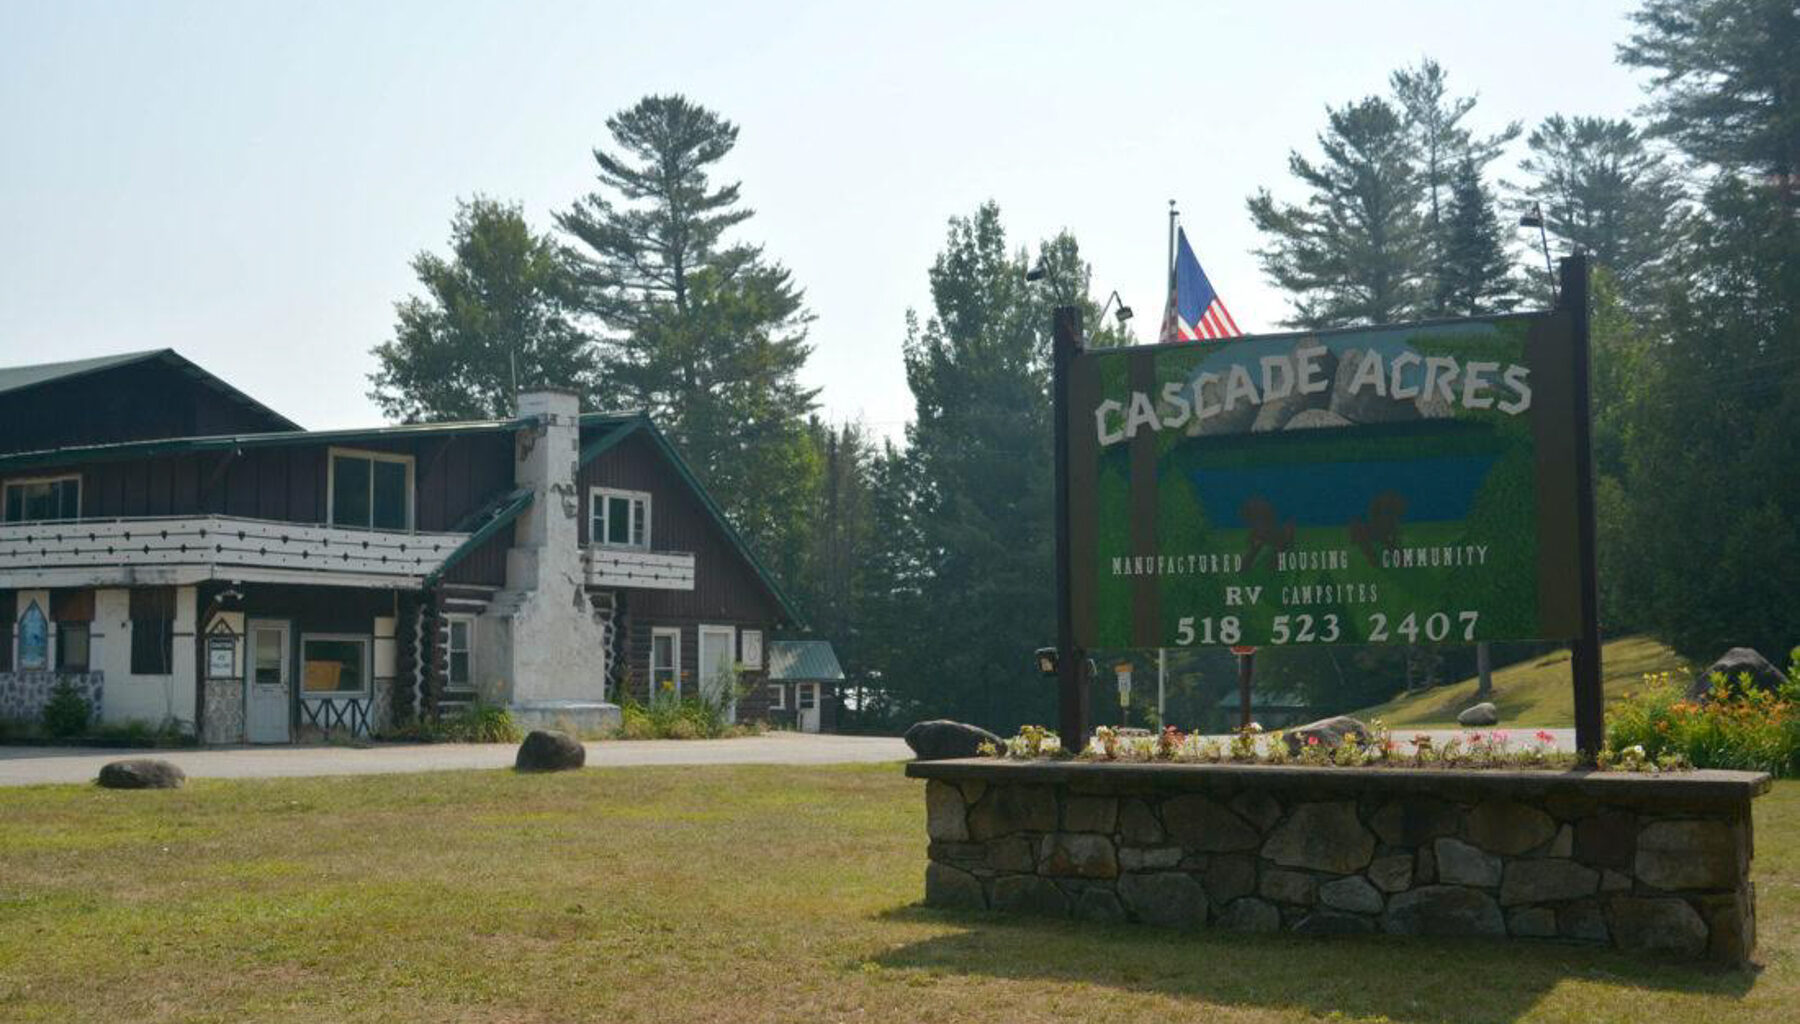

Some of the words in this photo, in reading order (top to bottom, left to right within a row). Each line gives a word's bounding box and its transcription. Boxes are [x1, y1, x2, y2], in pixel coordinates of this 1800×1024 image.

[1094, 345, 1329, 447] CASCADE
[1348, 348, 1533, 416] ACRES
[1111, 554, 1243, 575] MANUFACTURED
[1278, 550, 1349, 571] HOUSING
[1382, 545, 1489, 568] COMMUNITY
[1225, 585, 1263, 606] RV
[1281, 584, 1378, 605] CAMPSITES
[1175, 615, 1242, 645] 518
[1270, 612, 1341, 645] 523
[1367, 610, 1480, 644] 2407
